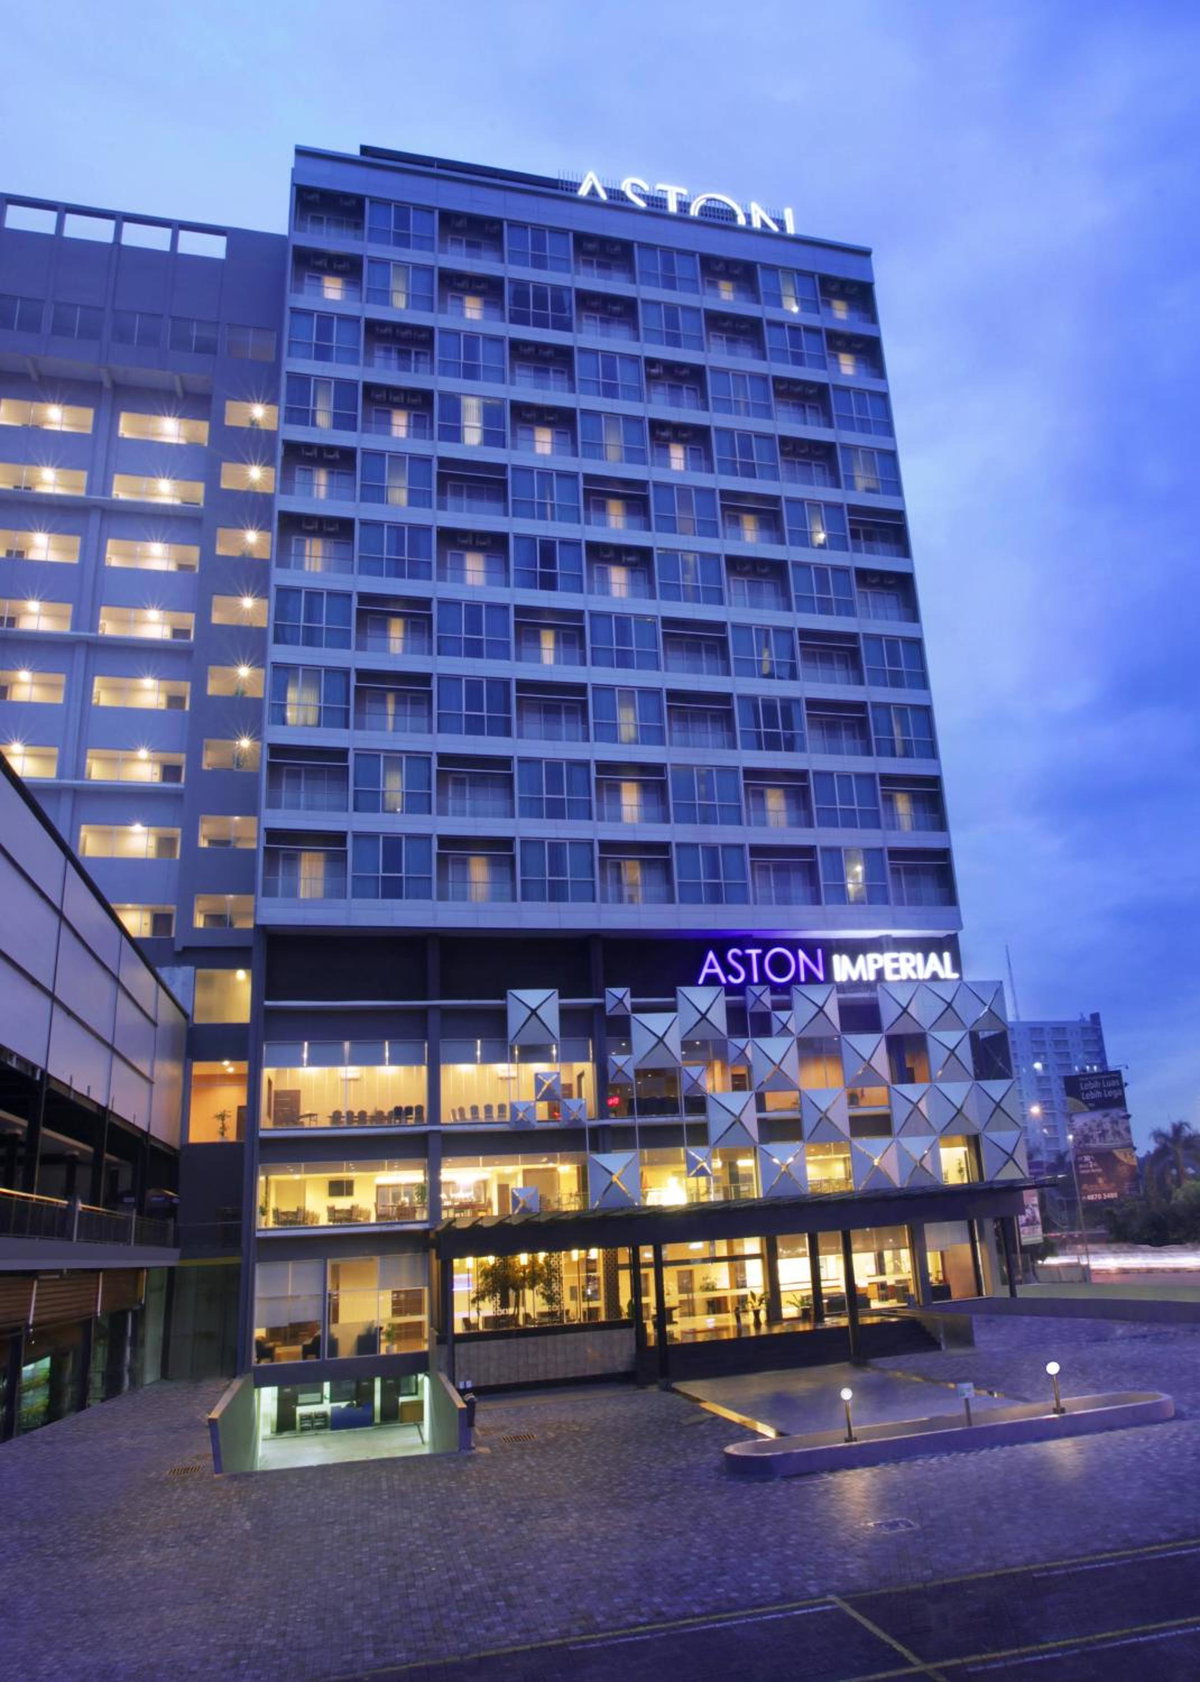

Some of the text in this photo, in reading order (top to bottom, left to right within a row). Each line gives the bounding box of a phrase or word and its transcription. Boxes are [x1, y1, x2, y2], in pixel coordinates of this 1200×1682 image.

[577, 170, 795, 235] ASTON
[697, 947, 960, 985] ASTON IMPERIAL
